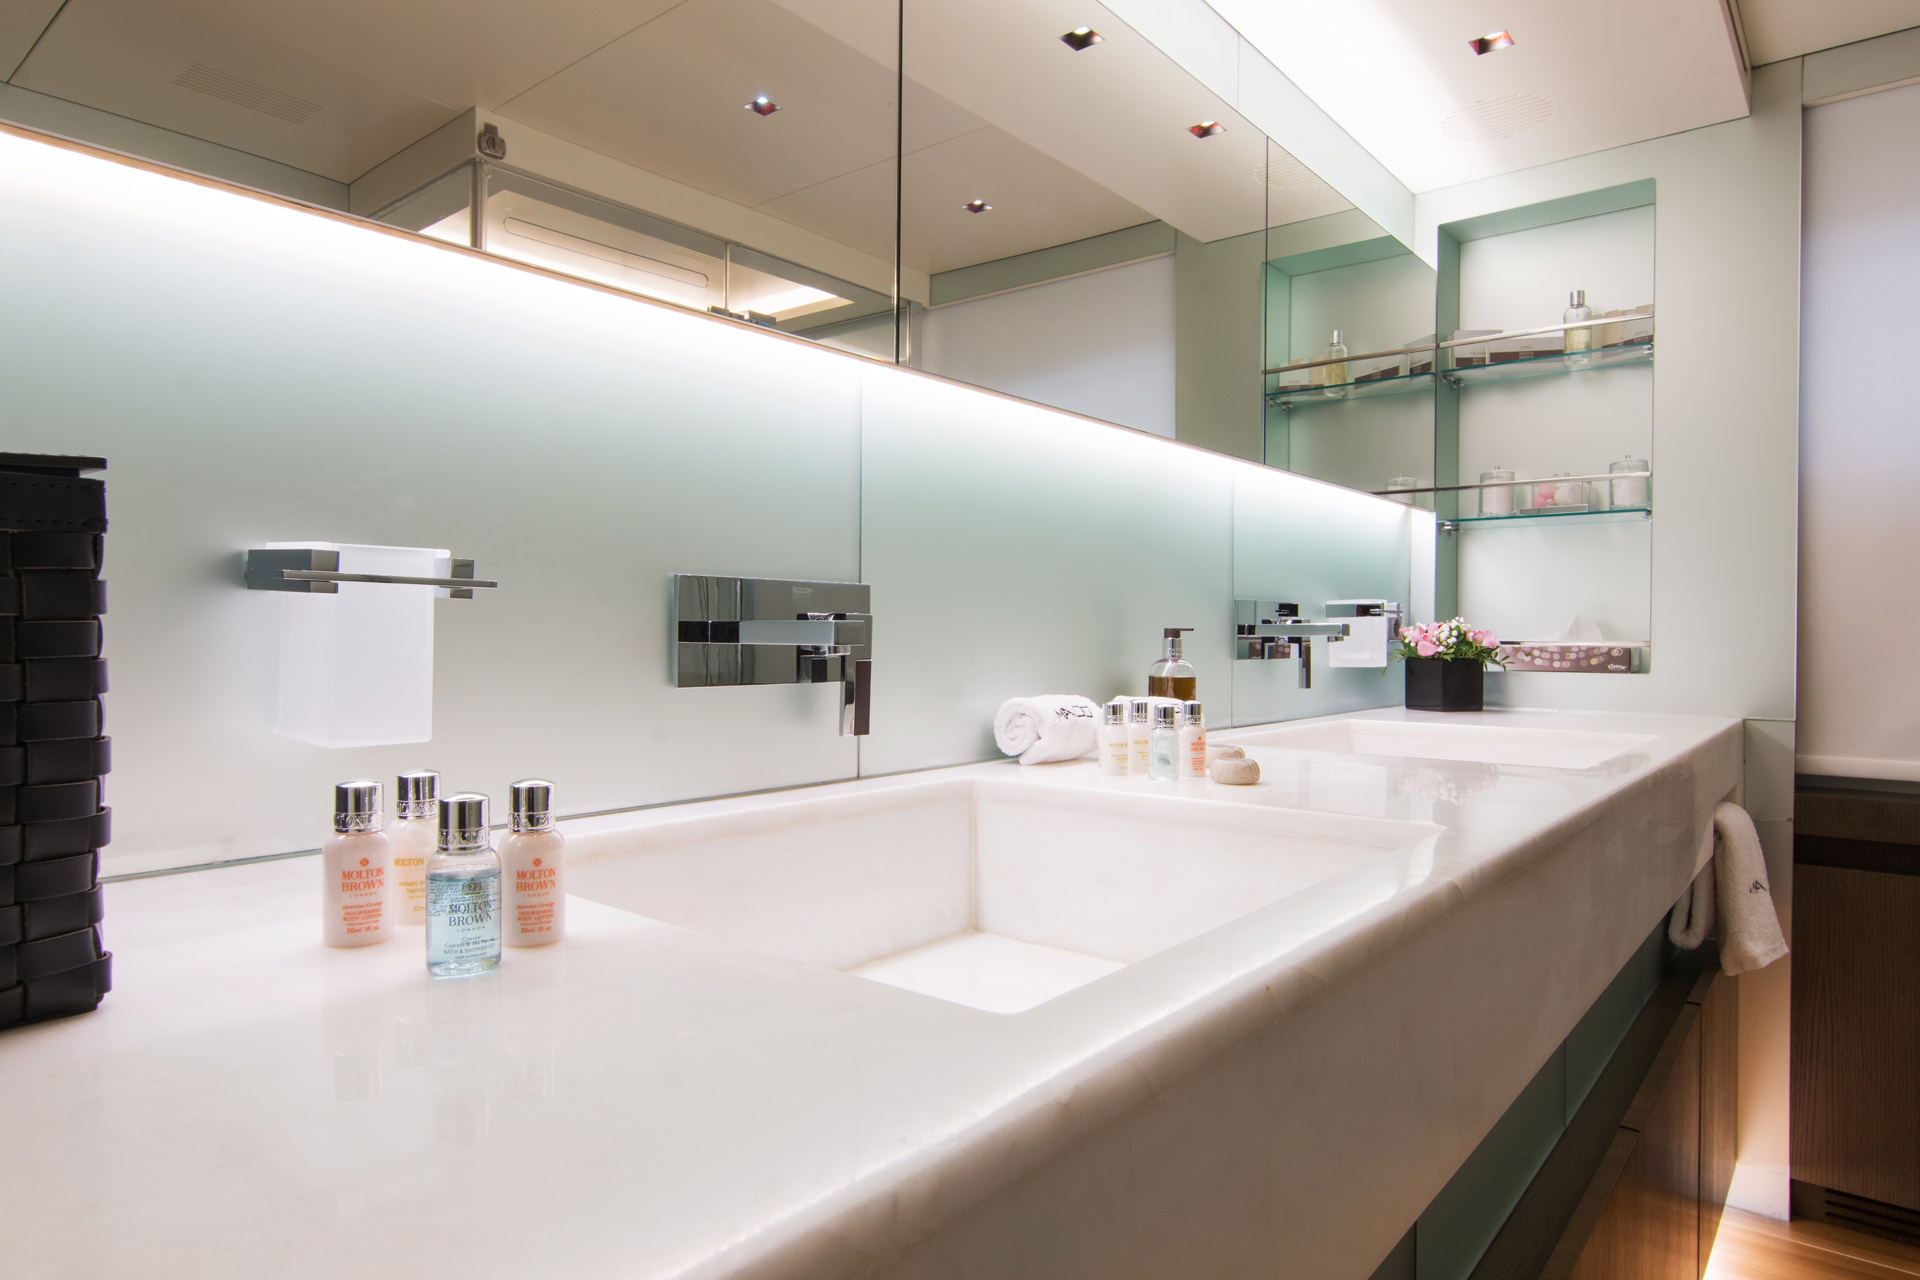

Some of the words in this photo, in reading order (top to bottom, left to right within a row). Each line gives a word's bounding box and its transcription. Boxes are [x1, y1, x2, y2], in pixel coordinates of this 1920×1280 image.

[342, 867, 384, 881] MOLTON
[516, 868, 556, 881] MOLTON
[341, 878, 384, 893] BROWN
[515, 879, 556, 892] BROWN
[448, 900, 492, 915] MOLTON
[448, 912, 492, 927] BROWN
